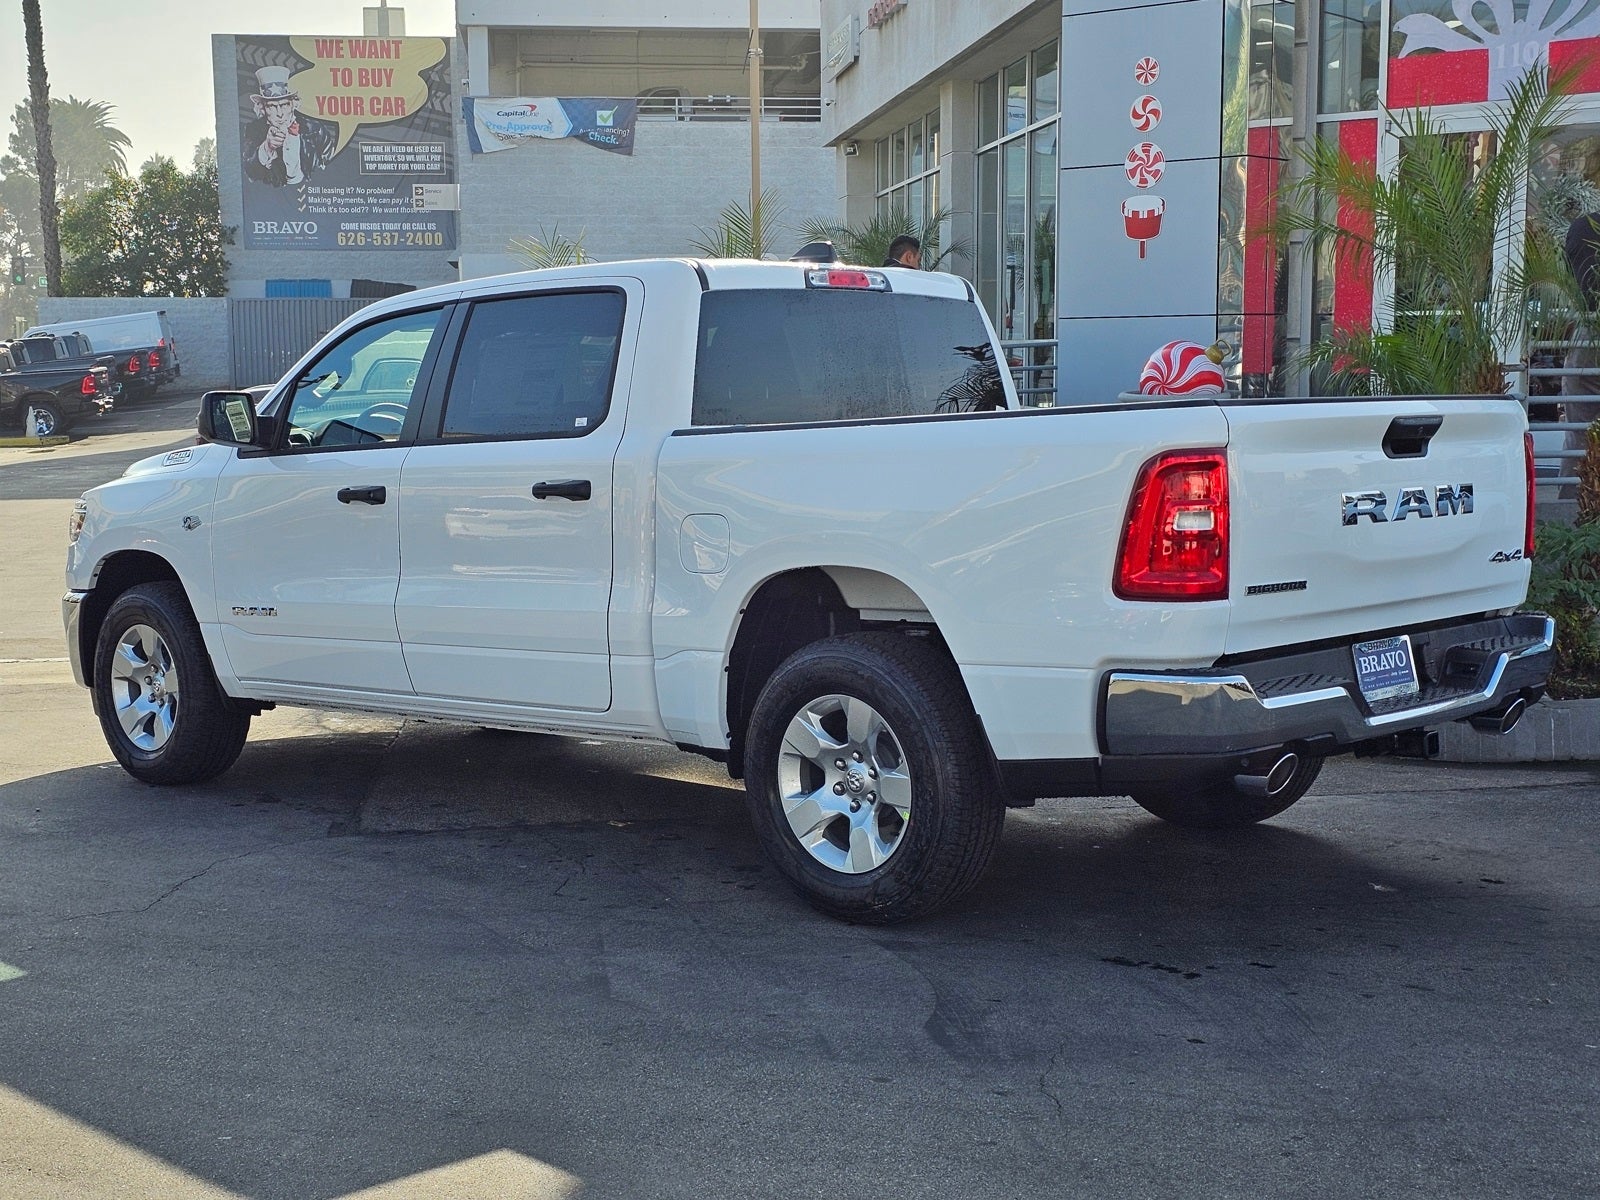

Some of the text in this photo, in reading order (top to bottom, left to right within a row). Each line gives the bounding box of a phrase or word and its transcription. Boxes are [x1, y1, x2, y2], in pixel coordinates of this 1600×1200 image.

[314, 38, 403, 60] WE WANT
[1495, 41, 1541, 68] 110
[329, 67, 394, 88] TO BUY
[315, 95, 406, 117] YOUR CAR
[307, 186, 321, 194] Still
[321, 186, 345, 195] leasing
[345, 186, 355, 194] it?
[366, 187, 395, 195] problem!
[308, 196, 331, 205] Making
[332, 196, 366, 205] Payments,
[367, 196, 378, 204] We
[391, 198, 404, 206] pay
[404, 196, 411, 204] it
[308, 206, 327, 214] Think
[252, 221, 318, 235] BRAVO
[340, 222, 360, 230] COME
[381, 222, 401, 230] TODAY
[402, 222, 412, 230] OR
[411, 222, 427, 230] CALL
[427, 222, 437, 230] US
[337, 232, 443, 246] 626-537-2400
[1341, 483, 1474, 526] RAM
[1359, 650, 1407, 675] BRAVO
